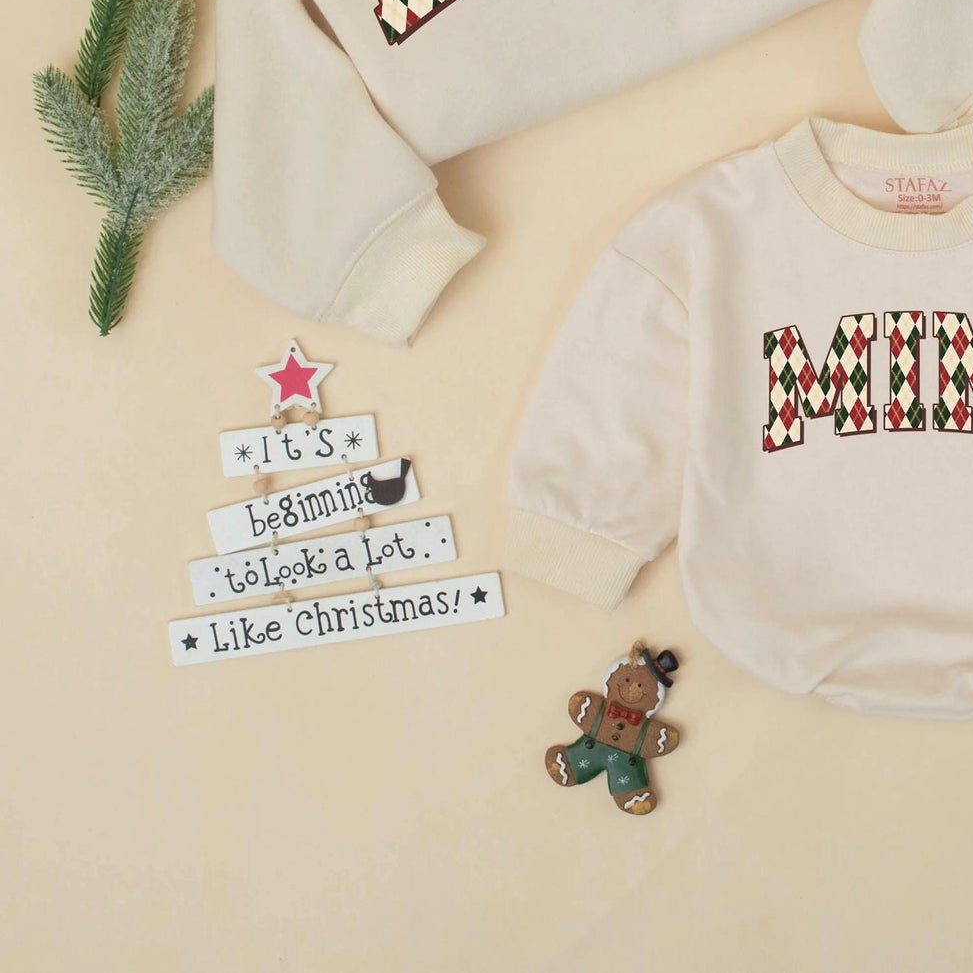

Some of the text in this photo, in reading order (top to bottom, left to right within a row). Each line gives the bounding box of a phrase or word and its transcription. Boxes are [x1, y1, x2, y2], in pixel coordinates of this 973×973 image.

[885, 177, 952, 192] STAFAZ
[335, 548, 356, 571] a
[361, 533, 415, 567] Lot
[209, 589, 461, 654] Like Christmas!
